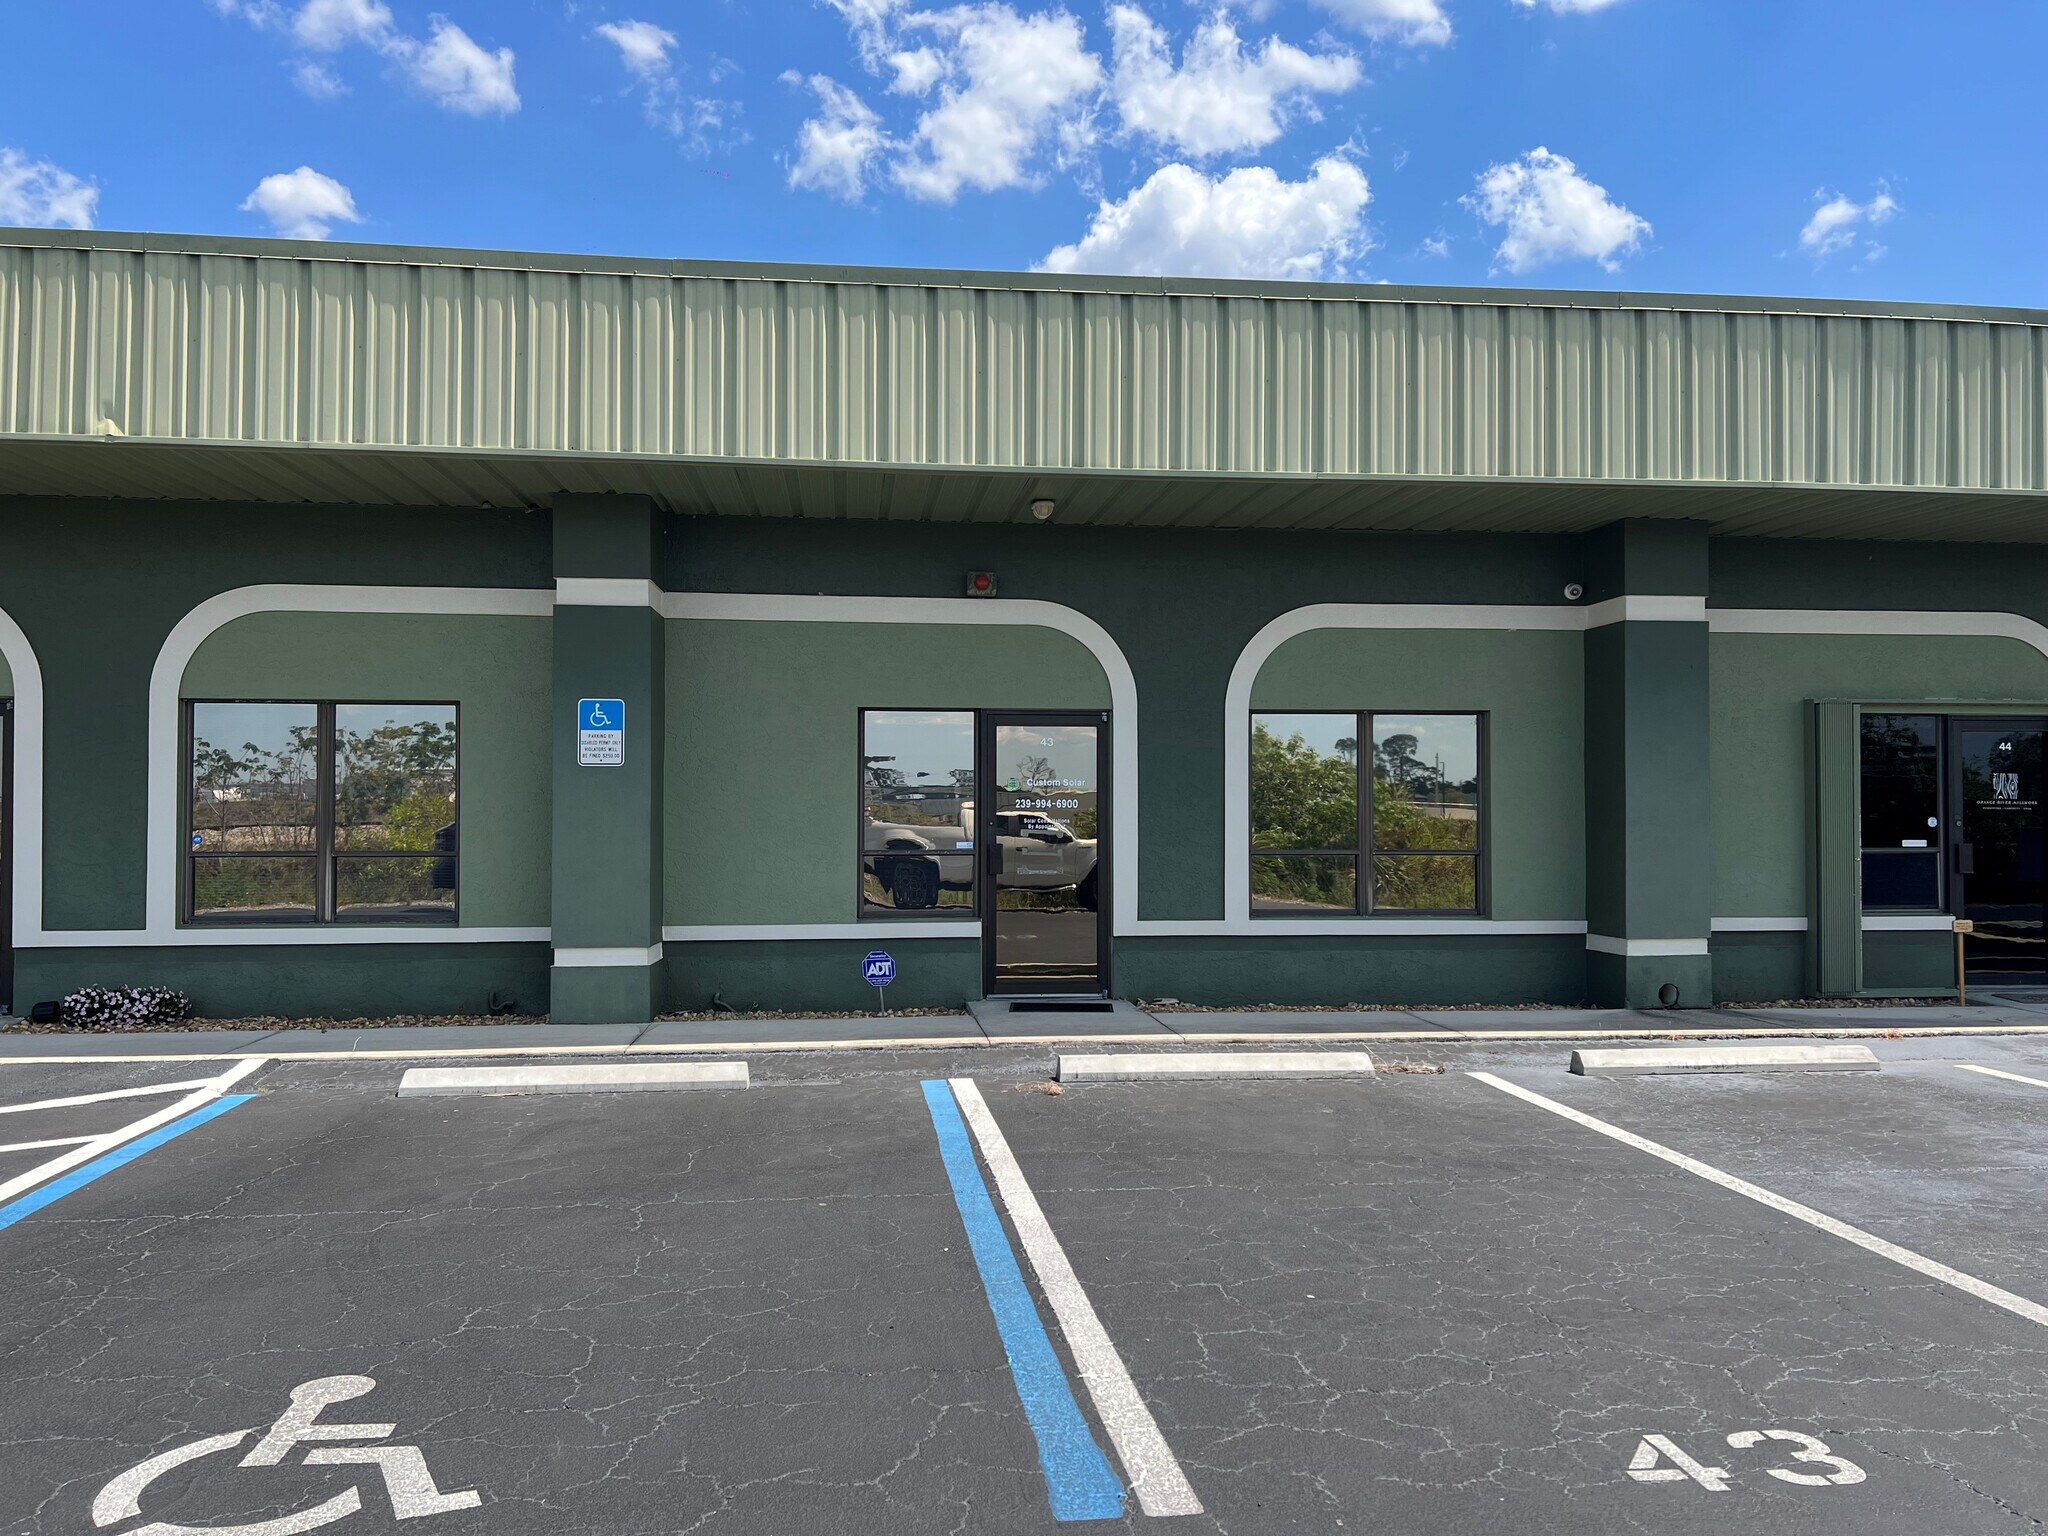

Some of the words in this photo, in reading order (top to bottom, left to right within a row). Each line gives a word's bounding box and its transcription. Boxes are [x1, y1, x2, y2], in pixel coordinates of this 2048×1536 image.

[1040, 738, 1054, 746] 43
[2000, 742, 2012, 750] 44
[1026, 778, 1060, 786] Custom
[1062, 778, 1086, 786] Solar
[1015, 800, 1078, 808] 239-994-6900
[867, 962, 891, 976] ADT
[1626, 1429, 1867, 1492] 43
